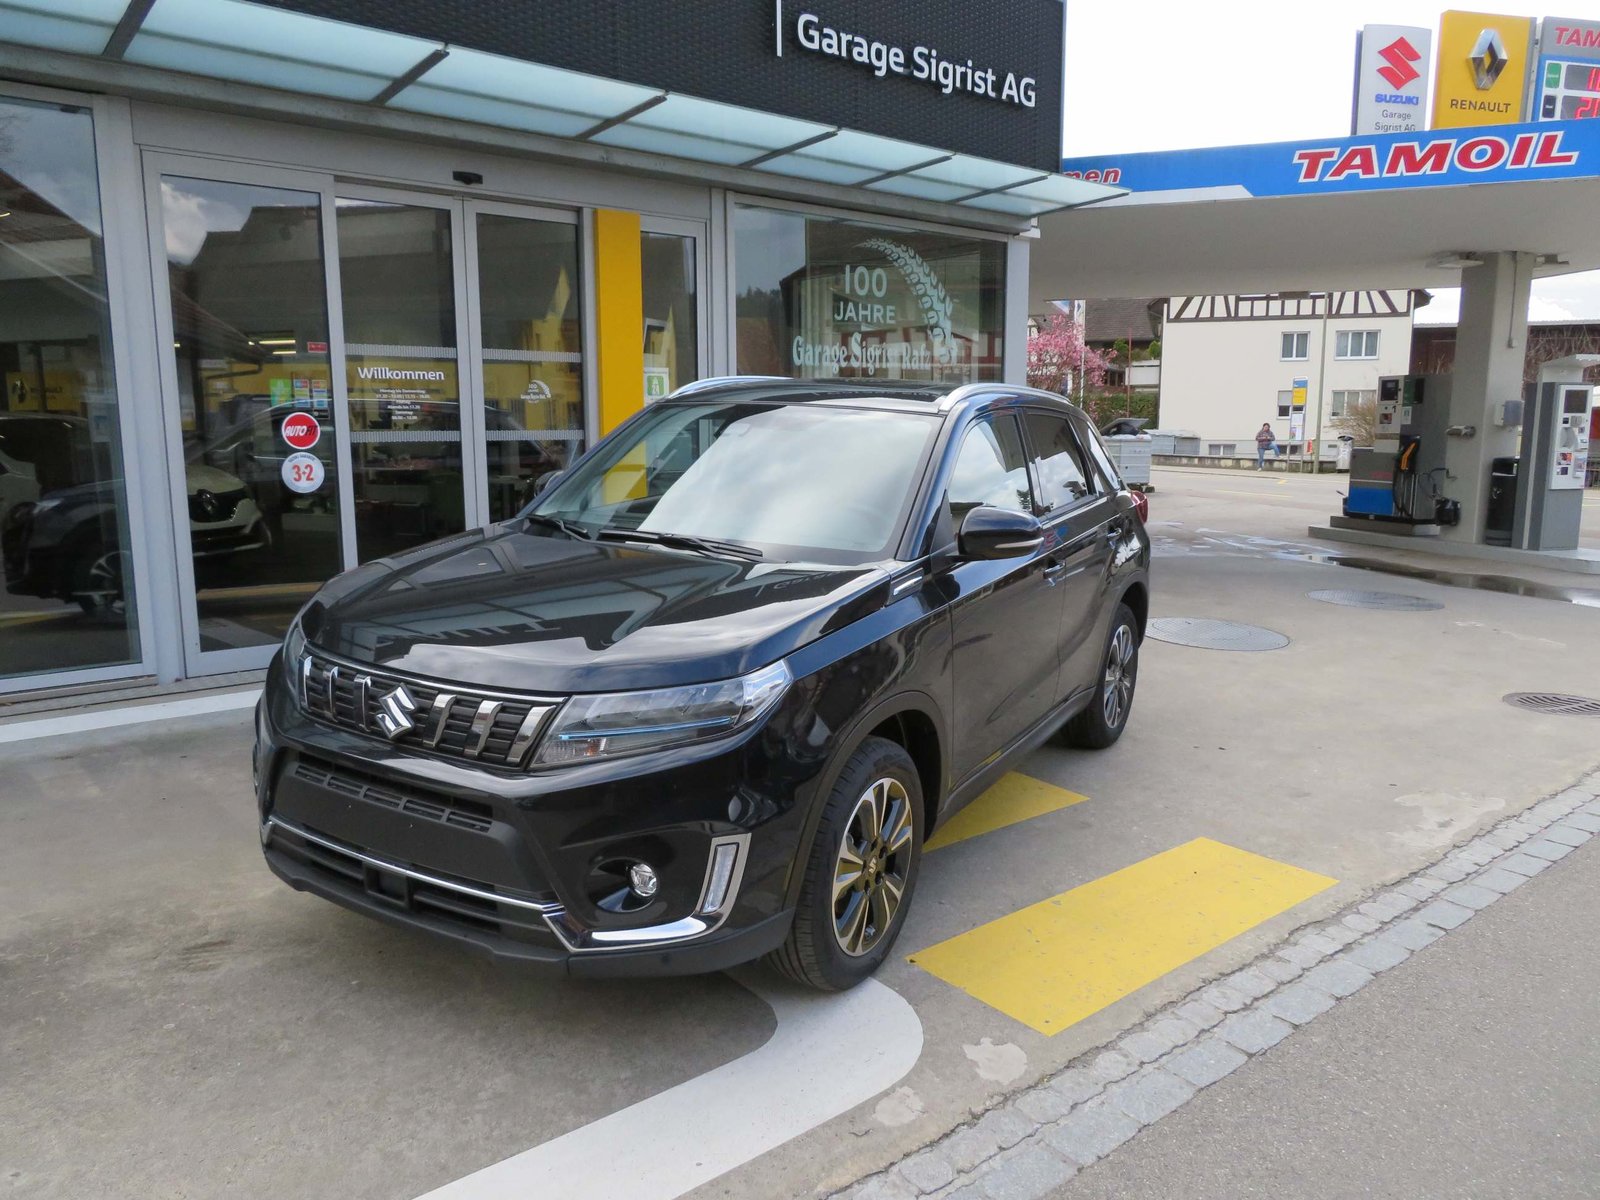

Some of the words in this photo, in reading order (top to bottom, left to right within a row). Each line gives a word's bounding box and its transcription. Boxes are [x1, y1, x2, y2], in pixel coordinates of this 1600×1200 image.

[797, 13, 904, 77] Garage
[913, 46, 996, 98] Sigrist
[1001, 72, 1036, 107] AG
[1375, 93, 1419, 105] SUZUKI
[1450, 99, 1511, 113] RENAULT
[1382, 109, 1411, 121] Garage
[1374, 122, 1401, 132] Sigrist
[1404, 124, 1416, 132] AG
[1292, 131, 1579, 183] TAMOIL
[844, 264, 888, 298] 100
[834, 301, 896, 325] JAHRE
[793, 336, 848, 374] Garage
[358, 366, 444, 380] Willkommen
